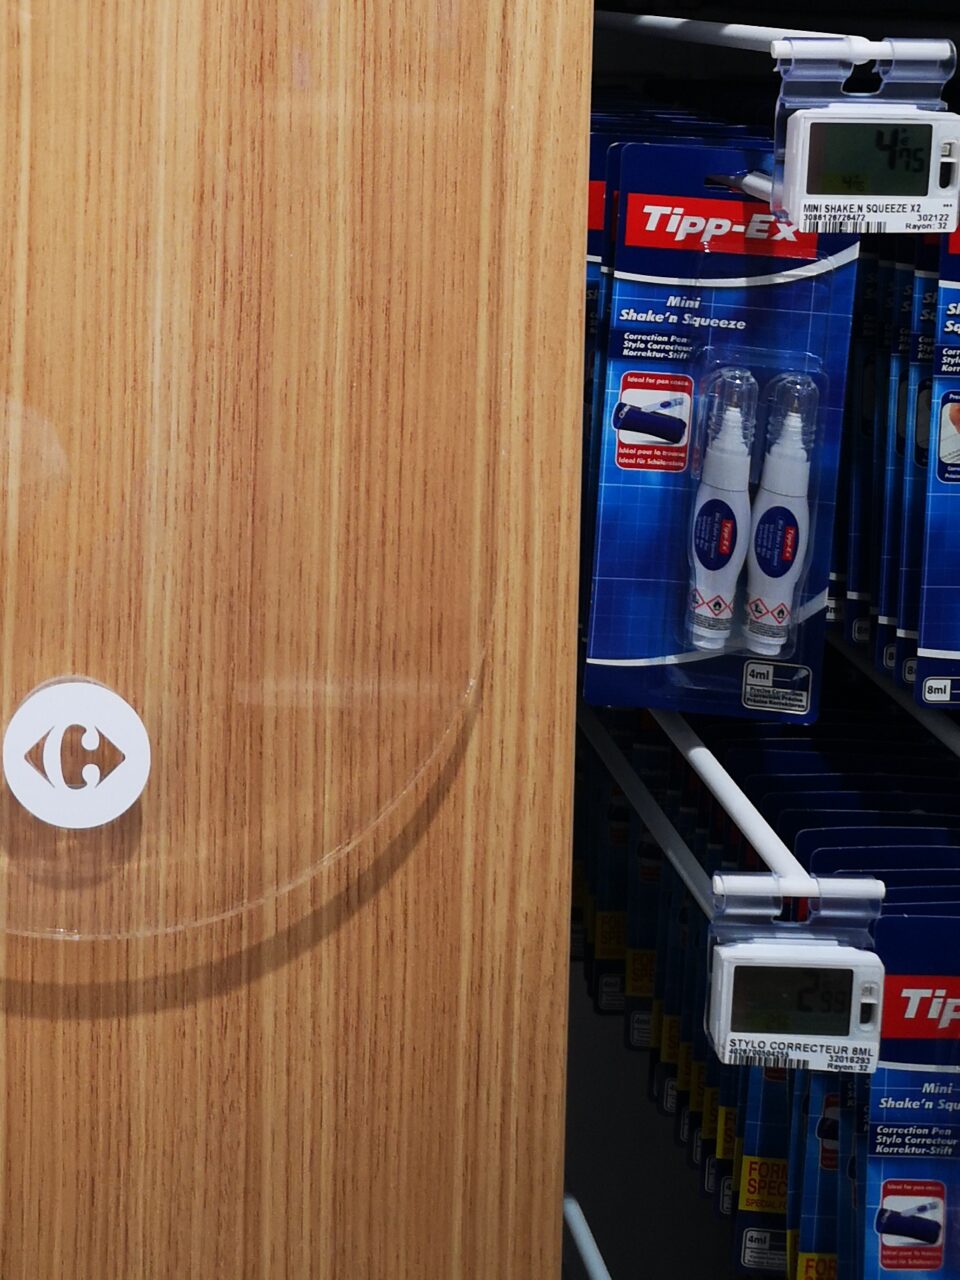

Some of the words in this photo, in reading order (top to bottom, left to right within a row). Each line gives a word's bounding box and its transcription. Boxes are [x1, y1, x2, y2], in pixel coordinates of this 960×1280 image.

[803, 203, 822, 213] MINI
[866, 204, 907, 213] SQUEEZE
[910, 204, 921, 213] X2
[642, 204, 799, 242] Tipp-Ex
[938, 222, 947, 230] 32
[666, 295, 701, 309] Mini
[682, 313, 747, 330] Squeeze
[624, 332, 669, 342] Correction
[623, 340, 646, 349] Stylo
[749, 669, 769, 680] 4ml
[927, 685, 947, 695] 8ml
[729, 1039, 766, 1050] STYLO
[769, 1041, 849, 1056] CORRECTEUR
[852, 1047, 874, 1057] 8ML
[921, 1082, 954, 1094] Mini
[876, 1125, 929, 1135] Correction
[875, 1134, 902, 1145] Stylo
[904, 1136, 959, 1146] Correcteur
[875, 1145, 953, 1156] Korrektur-Stift
